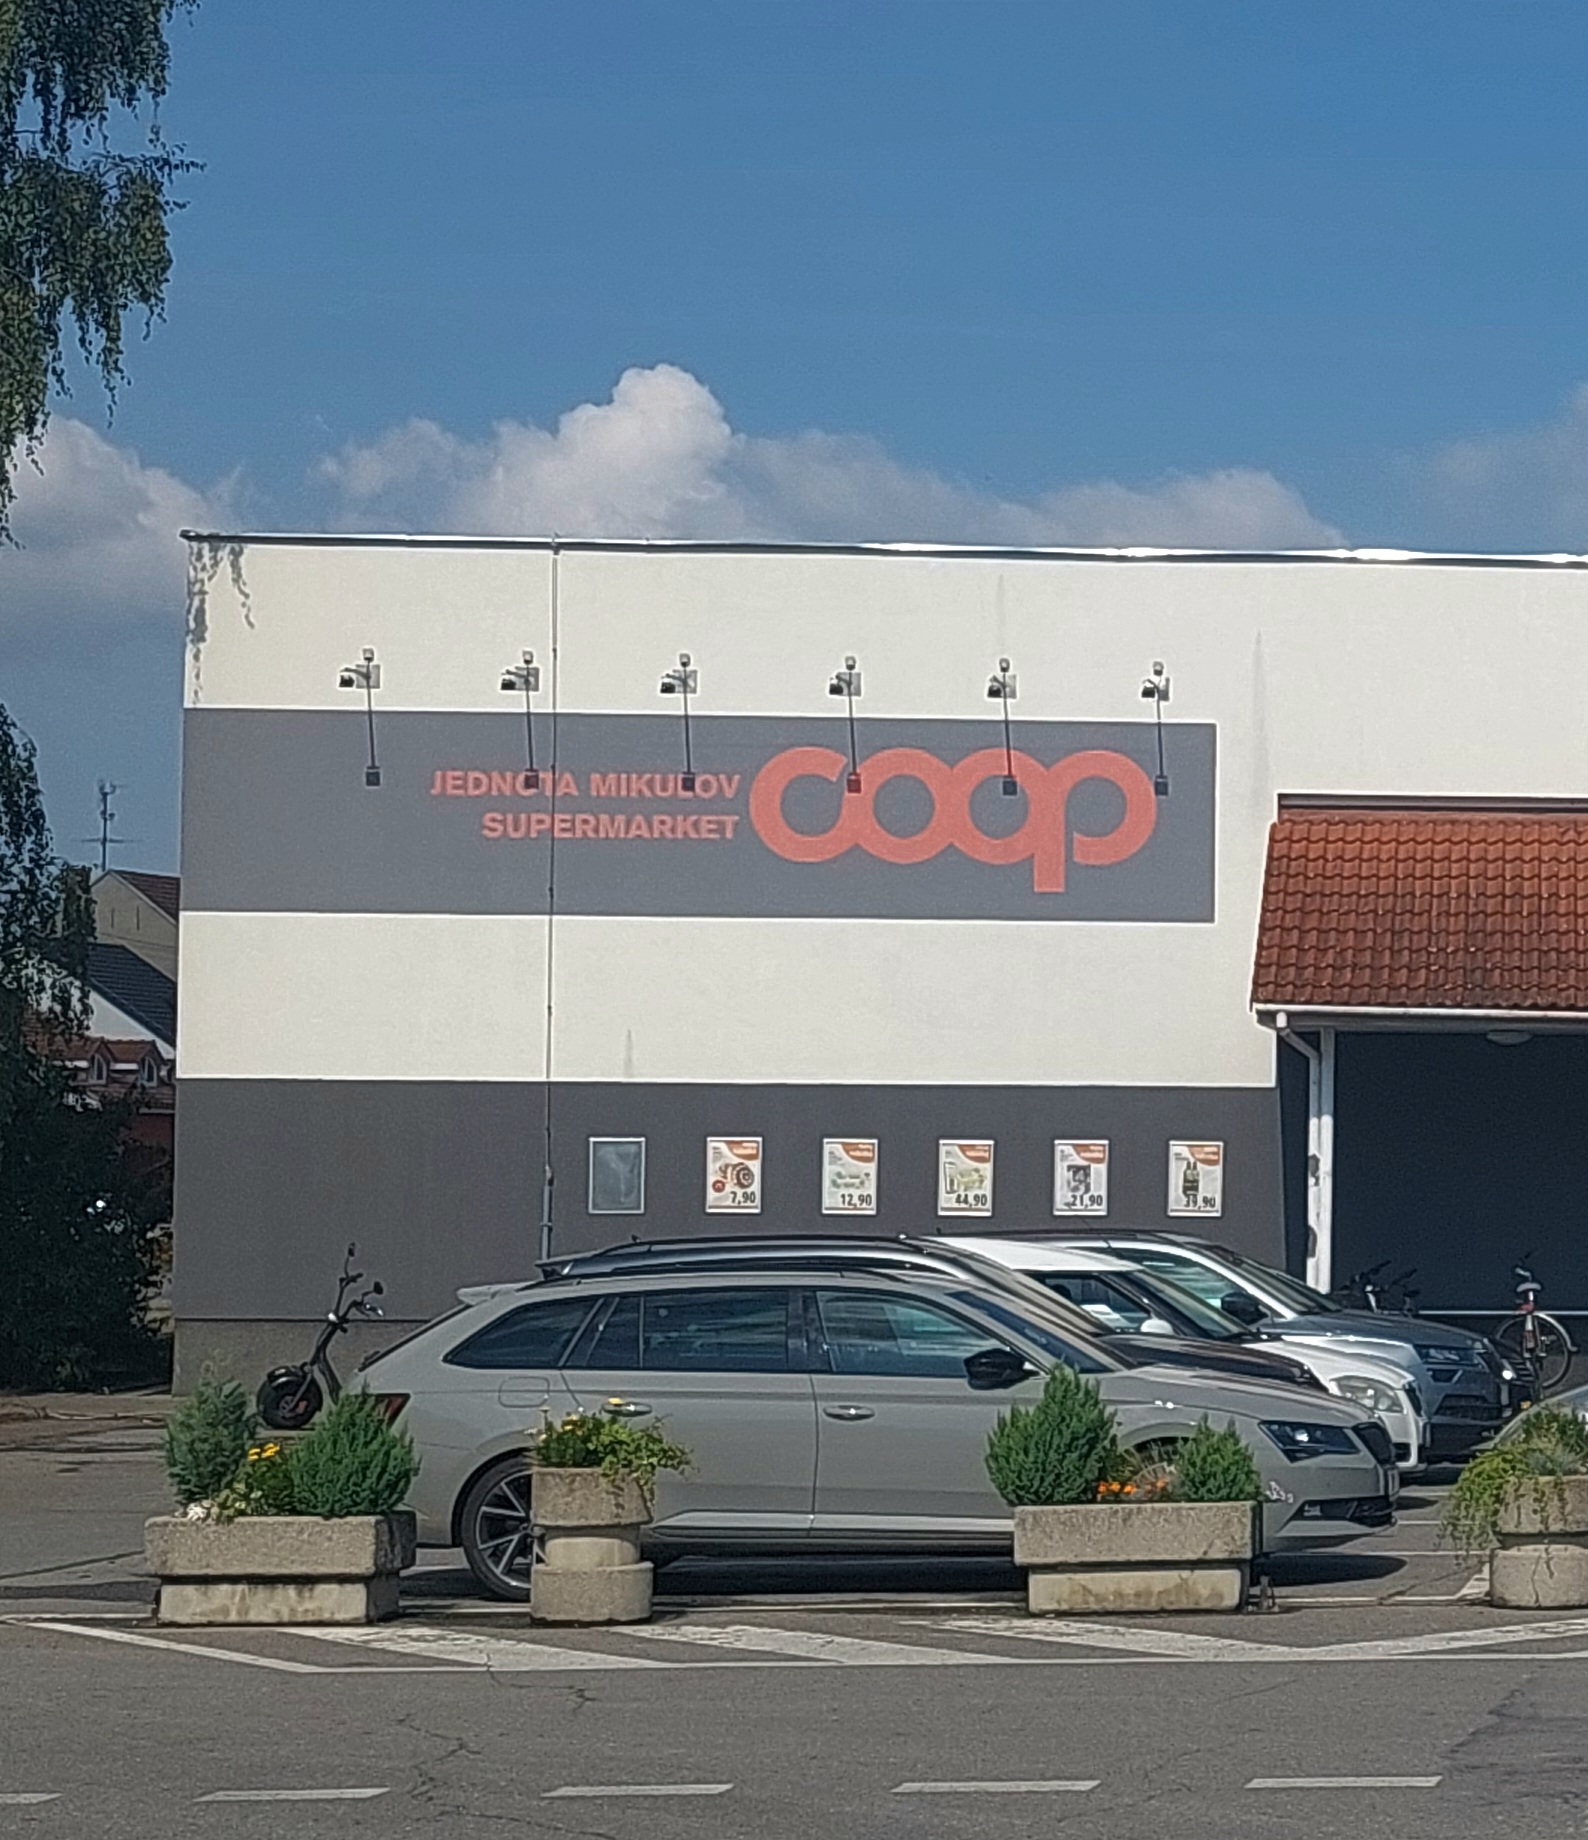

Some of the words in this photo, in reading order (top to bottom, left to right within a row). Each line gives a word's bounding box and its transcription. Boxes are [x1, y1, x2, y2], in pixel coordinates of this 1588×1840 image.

[590, 772, 741, 799] MIKULOV
[482, 812, 741, 839] SUPERMARKET
[730, 1191, 756, 1206] 7,90
[840, 1193, 873, 1208] 12,90
[955, 1193, 988, 1208] 44,90
[1070, 1194, 1103, 1209] 21,90
